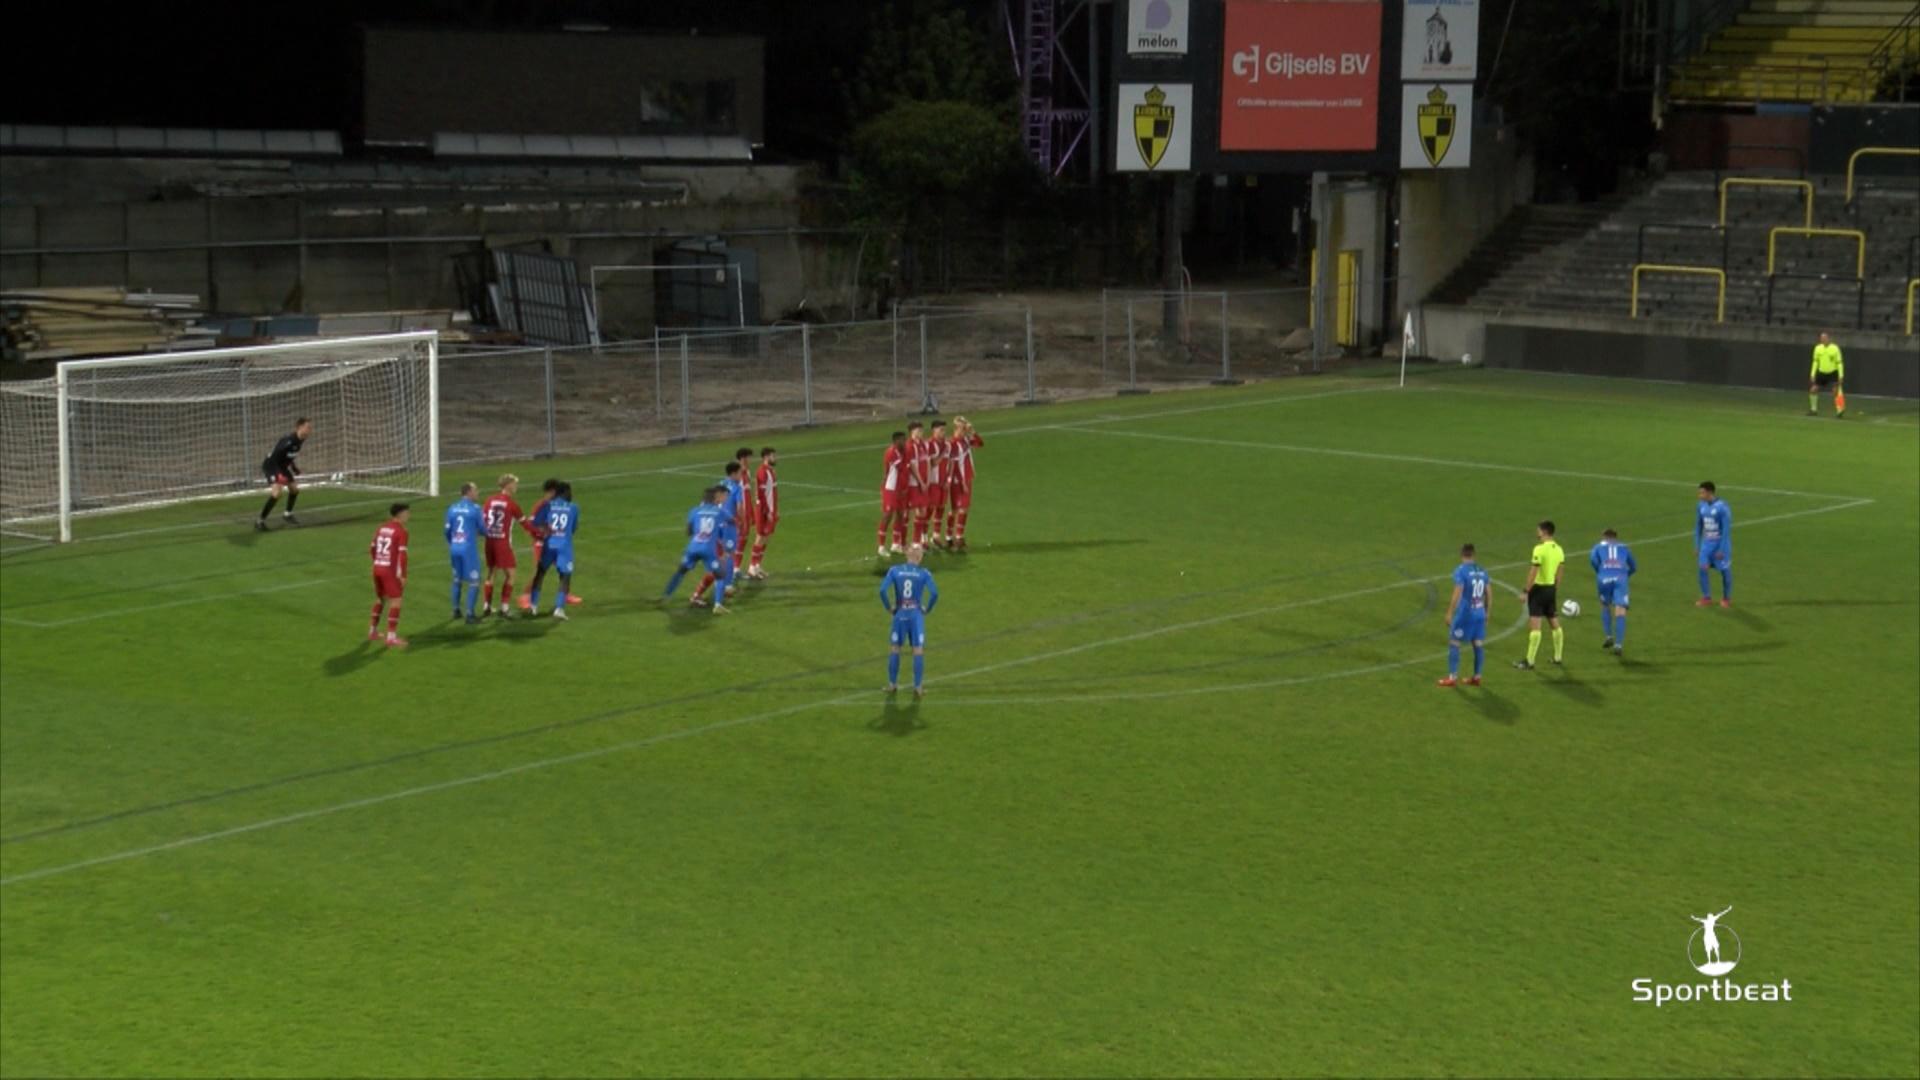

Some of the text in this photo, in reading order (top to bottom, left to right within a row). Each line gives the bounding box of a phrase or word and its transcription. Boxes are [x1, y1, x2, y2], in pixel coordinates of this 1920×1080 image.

[1138, 34, 1178, 48] melon
[1265, 53, 1336, 79] Gijsels
[1340, 53, 1371, 75] BV
[457, 516, 465, 534] 2
[551, 513, 569, 531] 29
[1608, 544, 1617, 561] 11
[903, 579, 912, 598] 8
